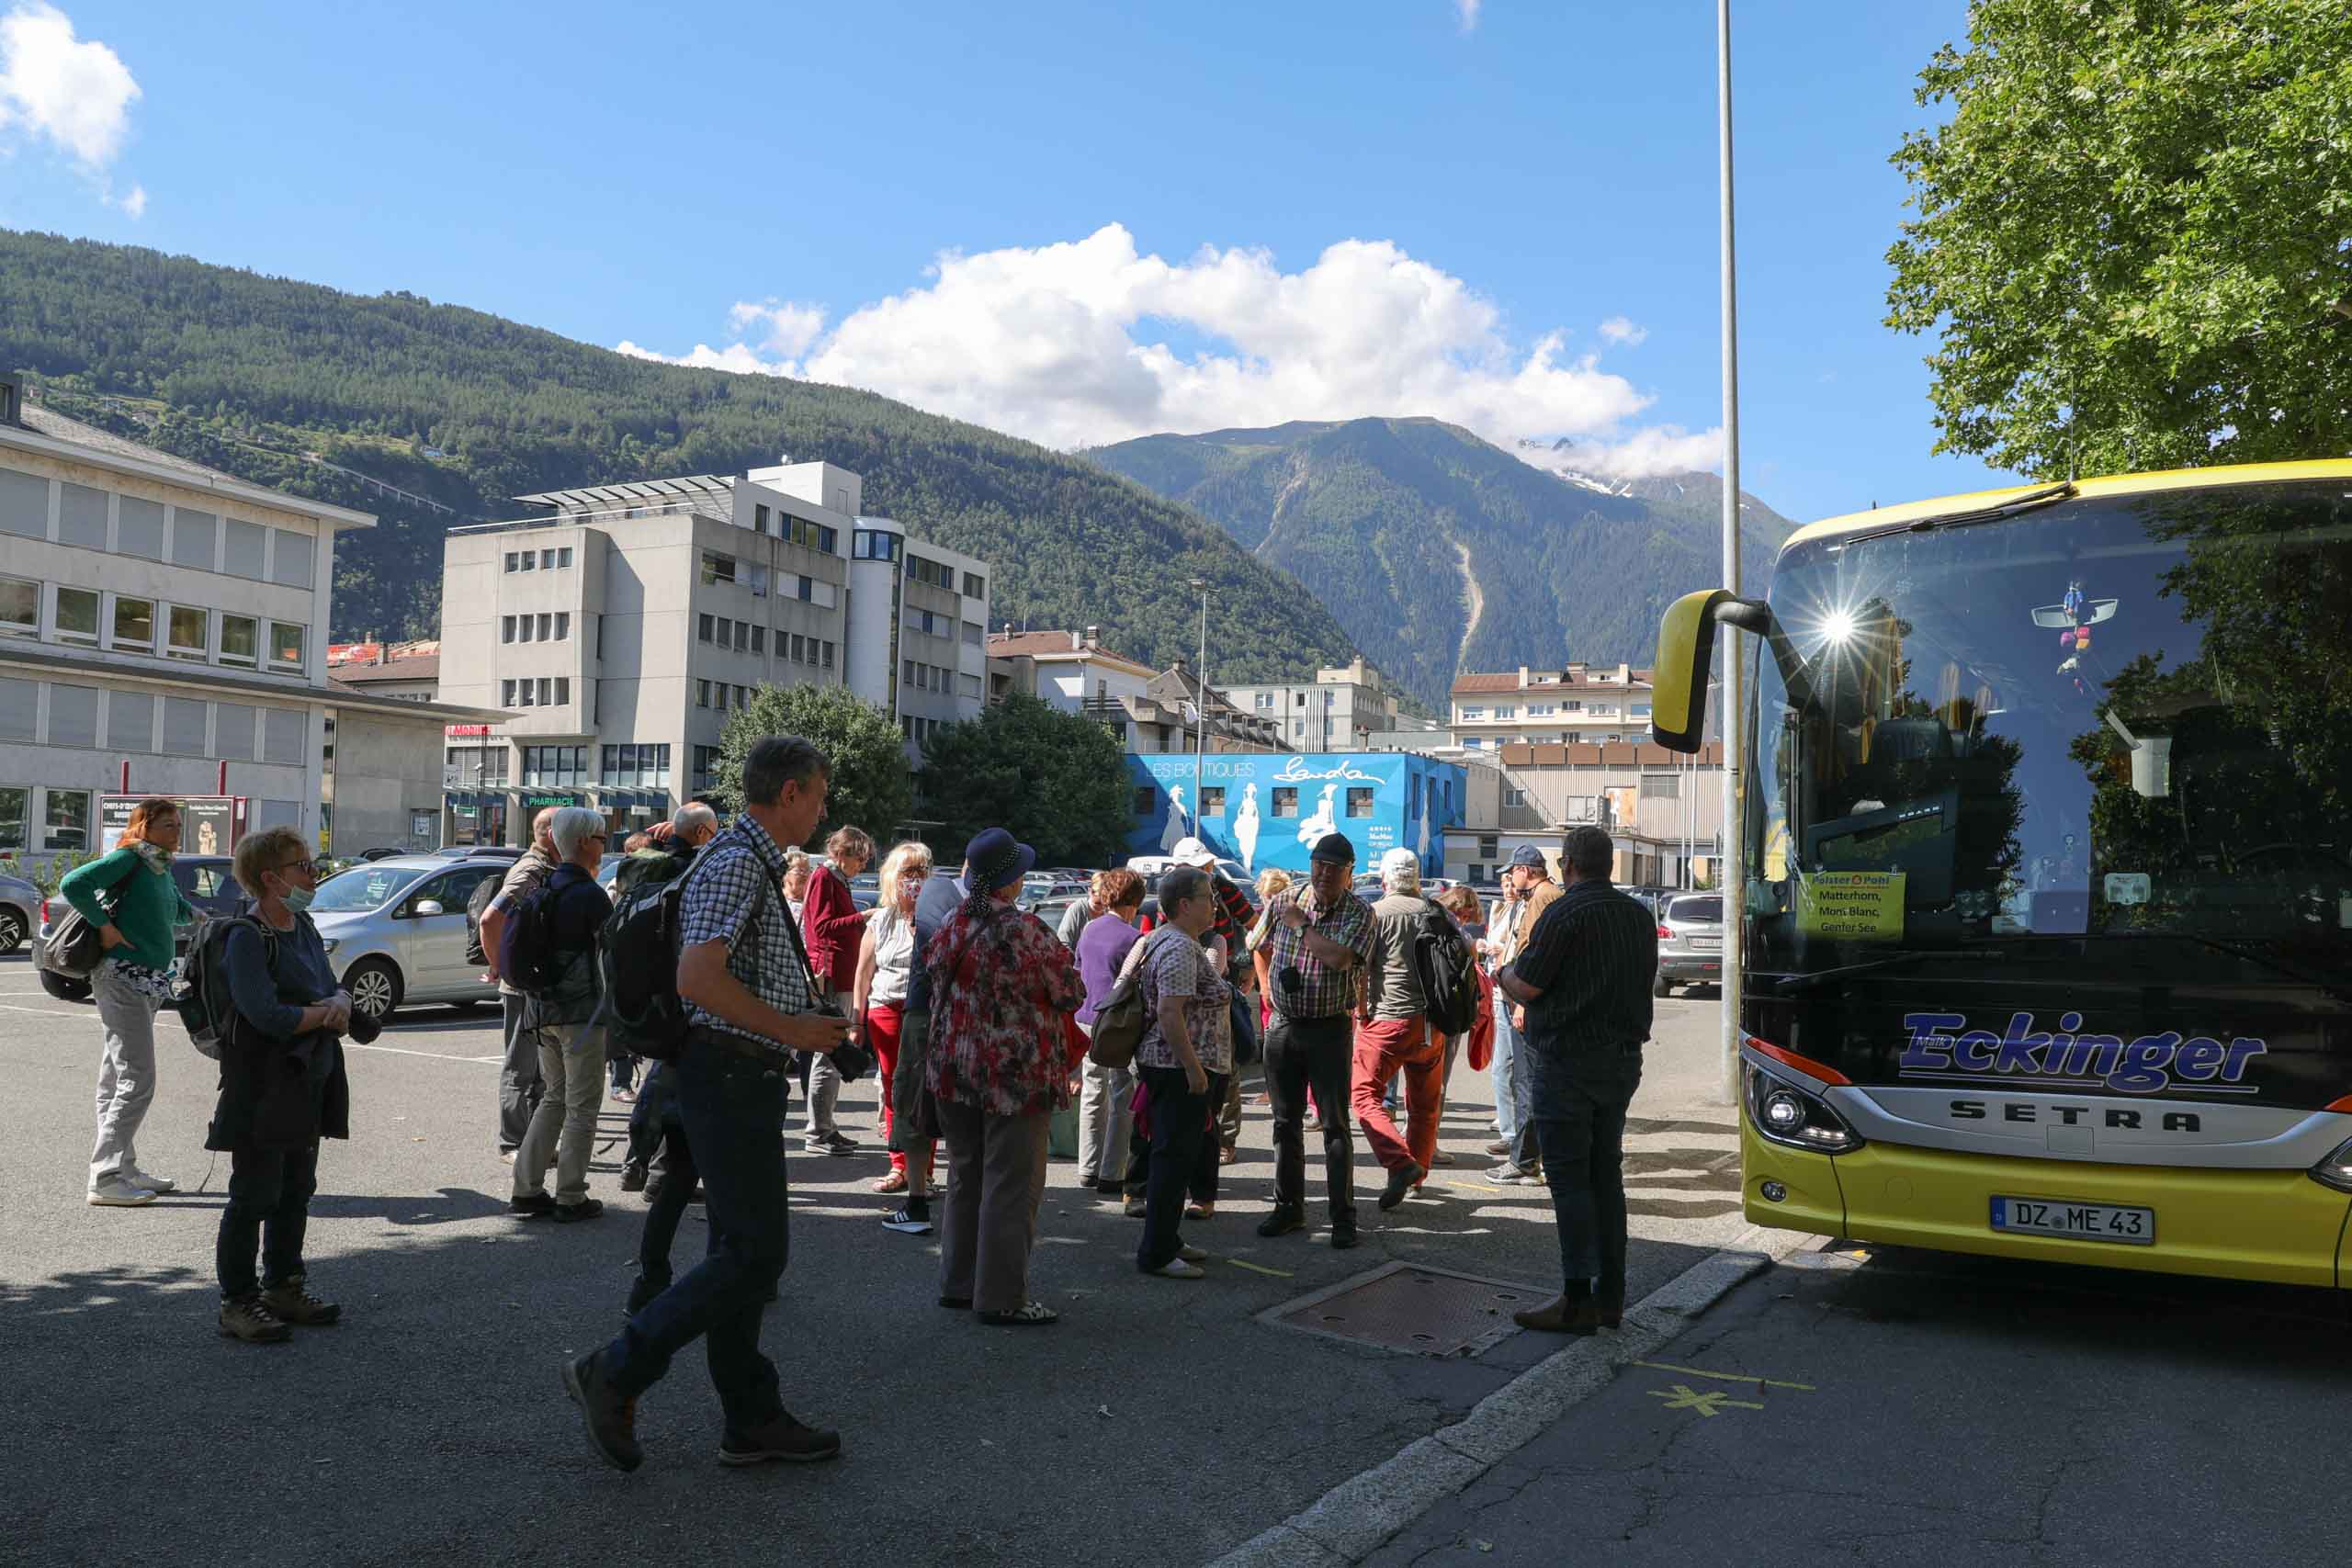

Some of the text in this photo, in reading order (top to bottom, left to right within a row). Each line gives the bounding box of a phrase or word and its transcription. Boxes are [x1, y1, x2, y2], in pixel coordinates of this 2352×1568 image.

[529, 796, 574, 806] PHARMACIE
[1819, 890, 1882, 902] Matterhorn,
[1819, 906, 1881, 918] Mont Blanc,
[1821, 922, 1876, 933] Genfer See
[1899, 1011, 2267, 1093] Eckinger
[1951, 1100, 2201, 1133] SETRA
[2016, 1203, 2049, 1227] DZ
[2067, 1207, 2102, 1232] ME
[2109, 1212, 2143, 1235] 43
